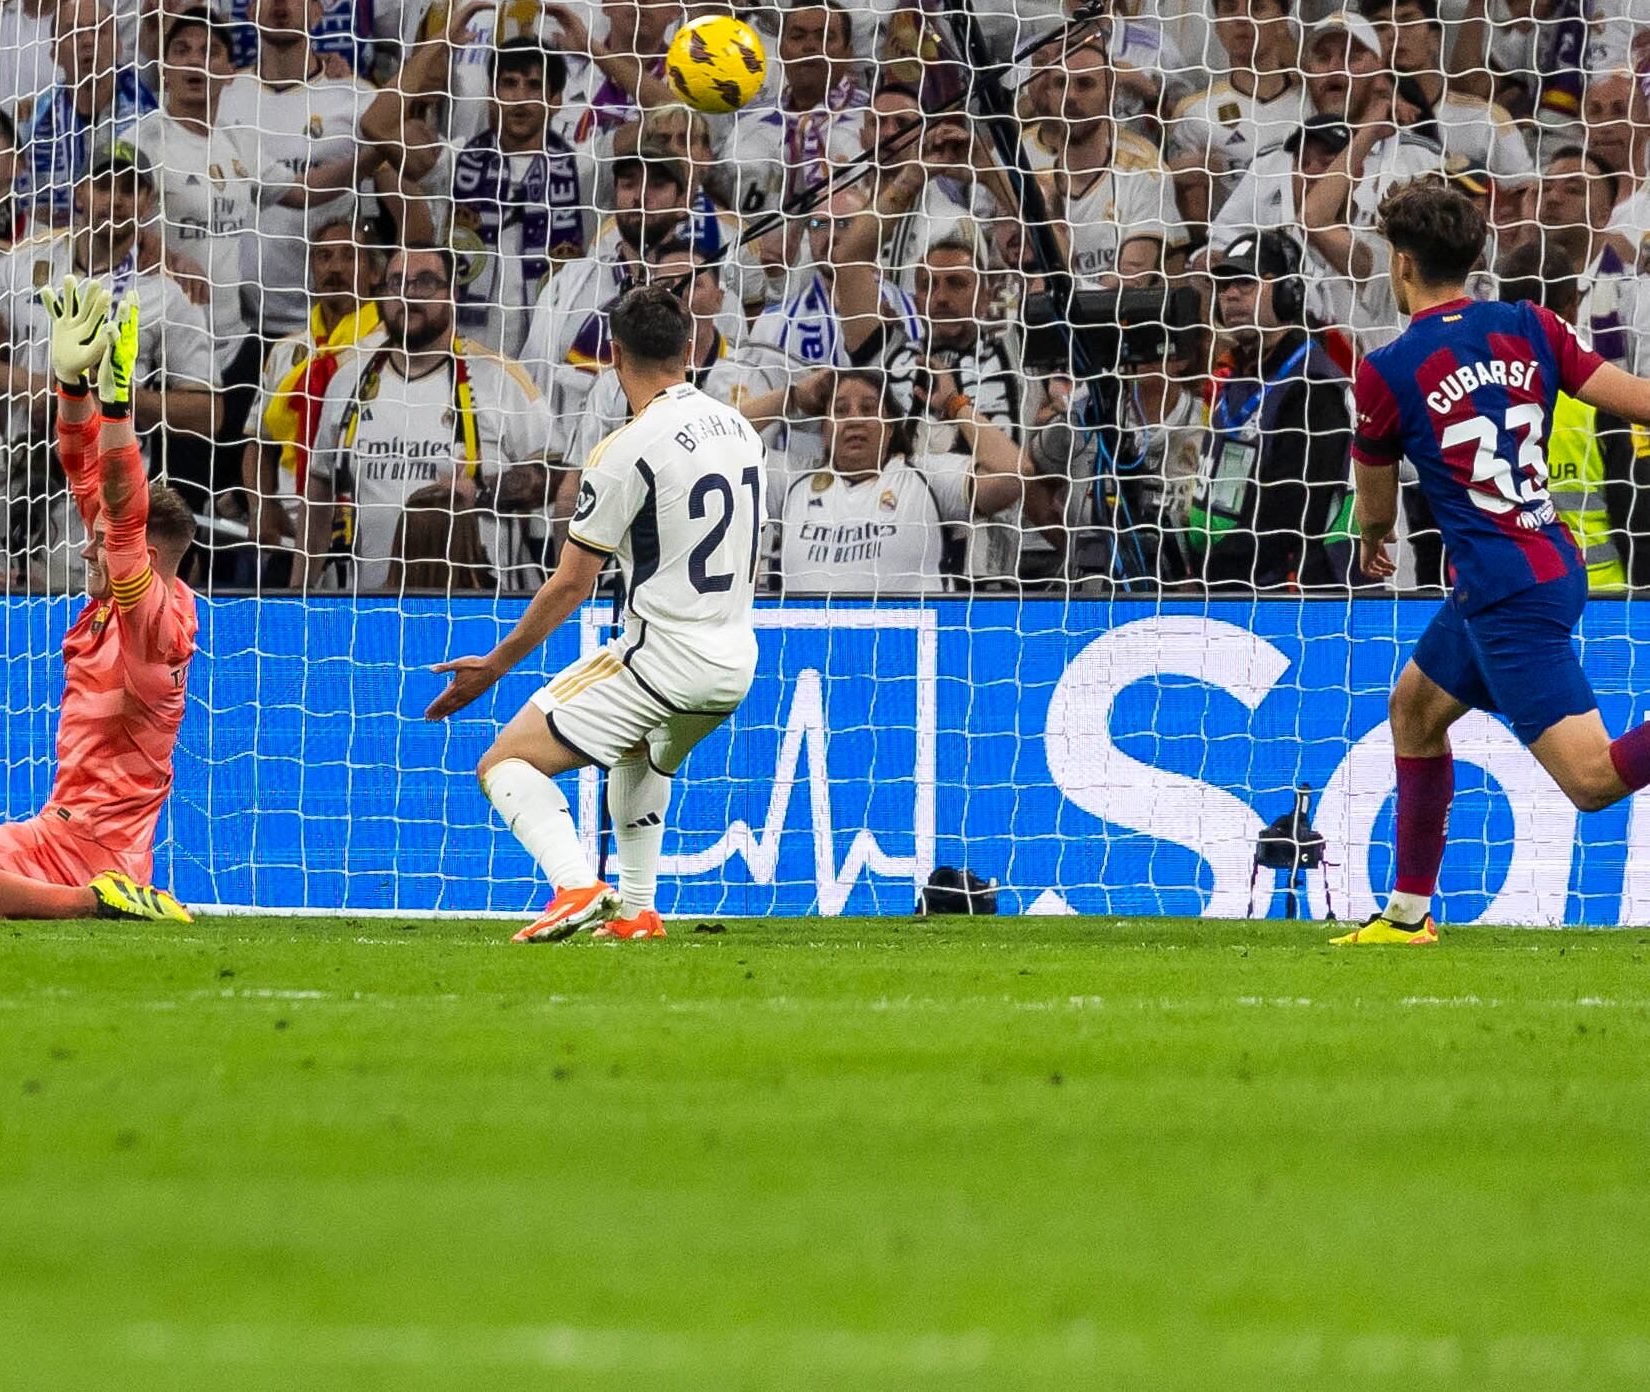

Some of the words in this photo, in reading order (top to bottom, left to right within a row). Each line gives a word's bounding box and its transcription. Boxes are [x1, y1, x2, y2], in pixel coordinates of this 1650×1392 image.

[356, 438, 451, 460] Emirates
[1439, 403, 1550, 517] 33
[365, 460, 394, 481] FLY
[397, 459, 438, 481] BETTER
[687, 468, 762, 595] 21
[799, 517, 897, 542] Emirates
